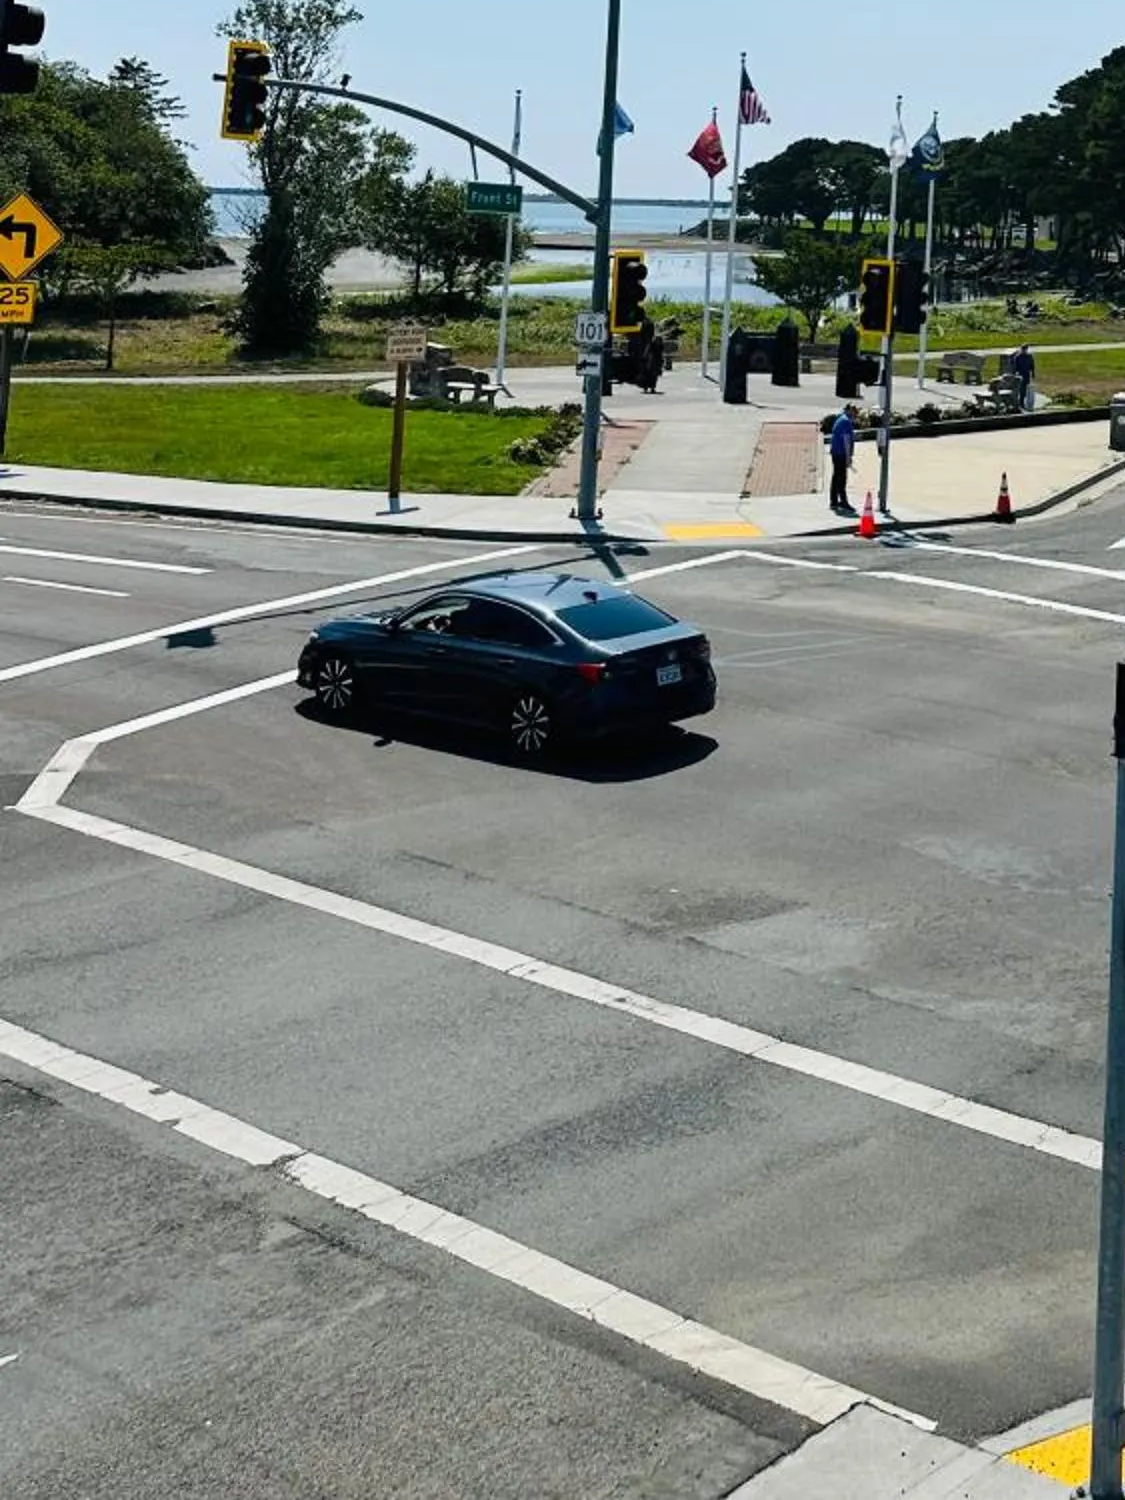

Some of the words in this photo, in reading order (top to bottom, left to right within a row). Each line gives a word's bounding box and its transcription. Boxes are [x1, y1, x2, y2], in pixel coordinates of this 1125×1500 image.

[505, 192, 518, 205] St
[0, 287, 29, 305] 25
[580, 323, 603, 340] 101
